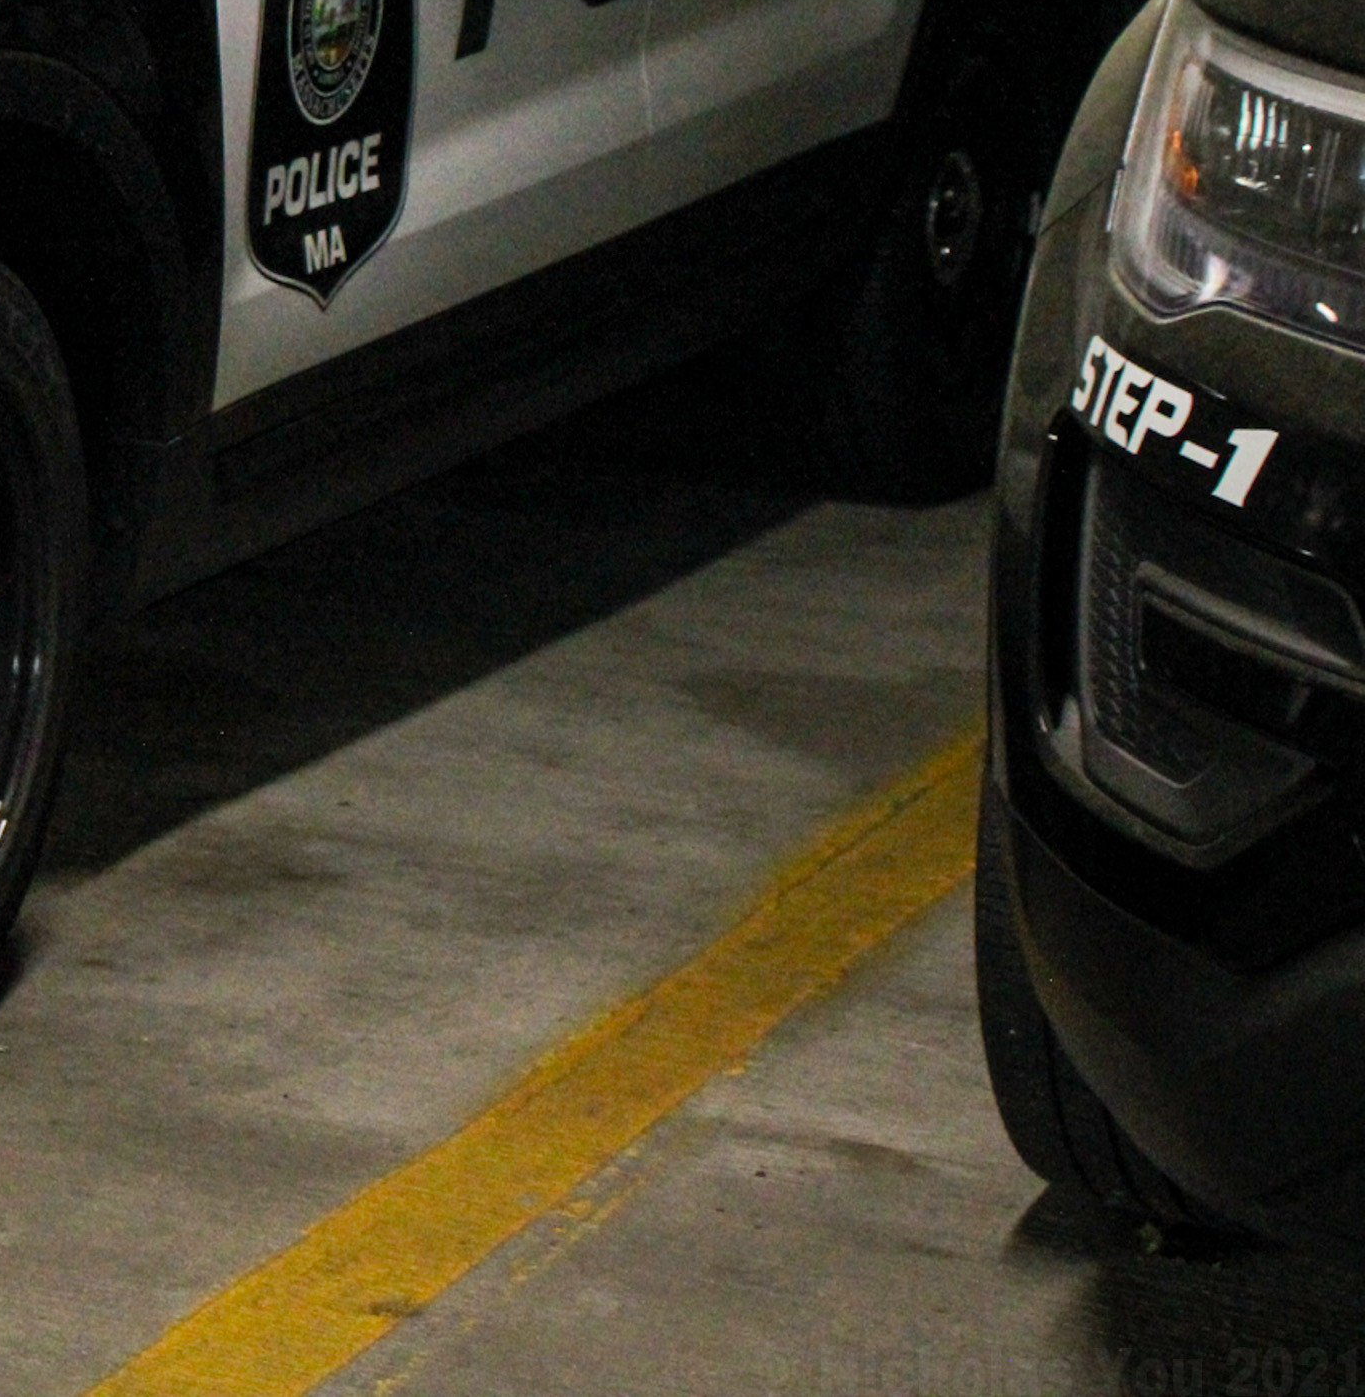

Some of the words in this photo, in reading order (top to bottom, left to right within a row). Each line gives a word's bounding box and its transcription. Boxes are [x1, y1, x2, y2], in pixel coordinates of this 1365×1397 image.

[263, 132, 383, 227] POLICE
[303, 224, 348, 275] MA
[1071, 334, 1280, 508] STEP-1
